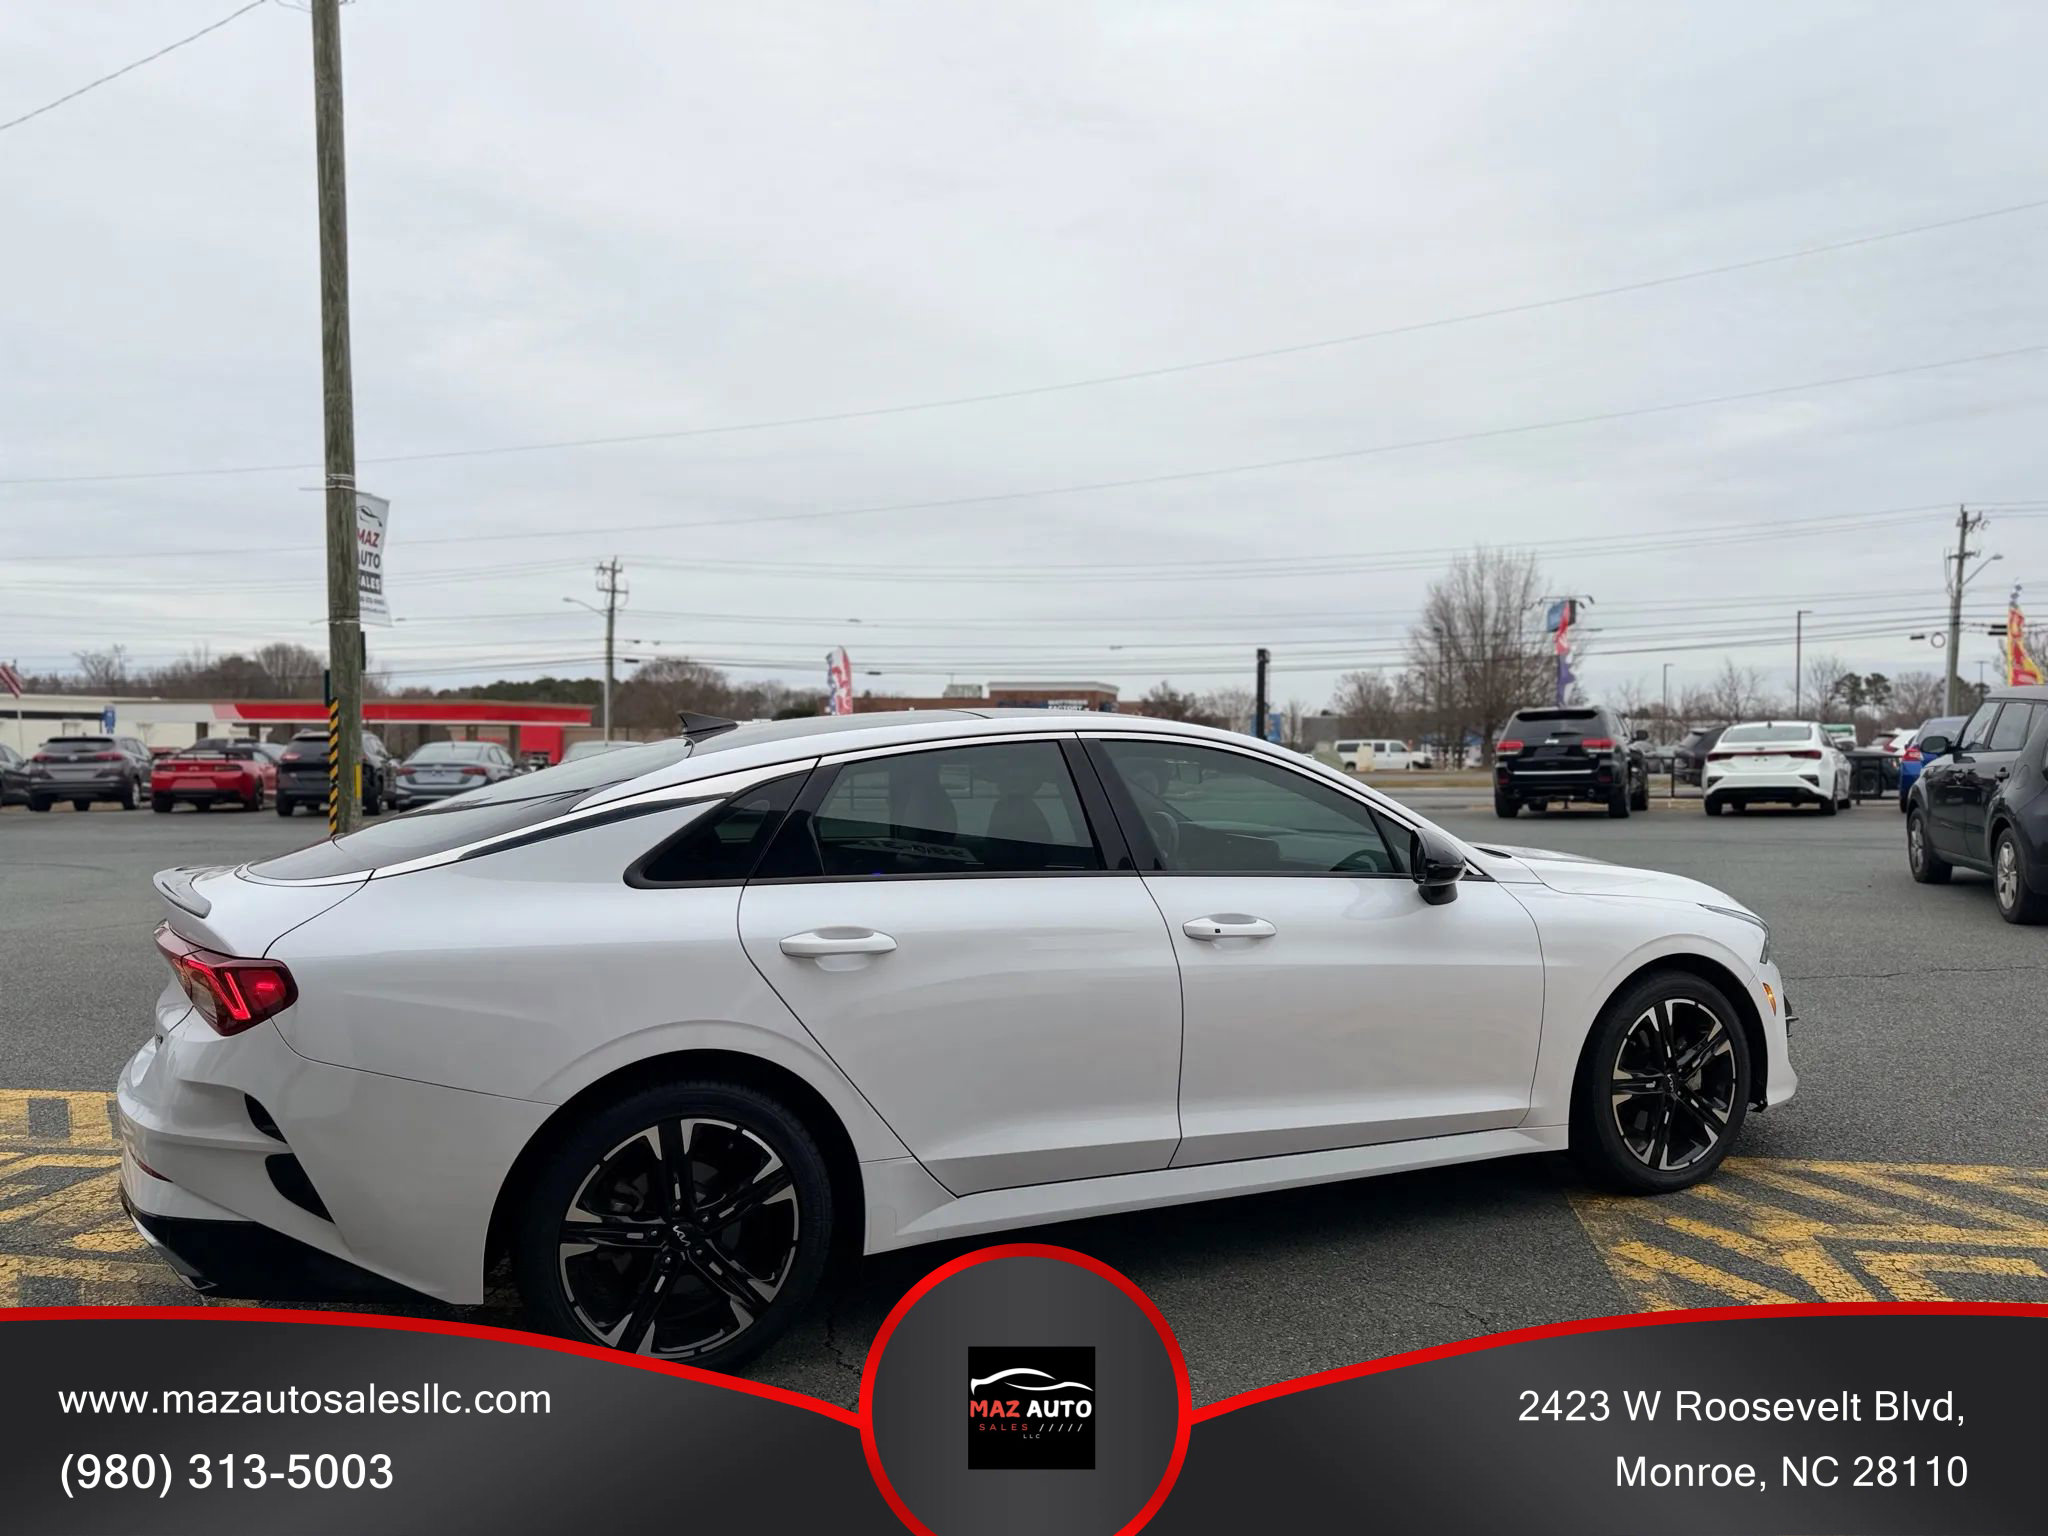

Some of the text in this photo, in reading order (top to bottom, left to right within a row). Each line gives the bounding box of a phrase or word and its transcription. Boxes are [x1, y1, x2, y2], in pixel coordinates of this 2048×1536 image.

[357, 529, 380, 547] MAZ
[358, 550, 381, 569] UTO
[360, 576, 380, 590] ALES
